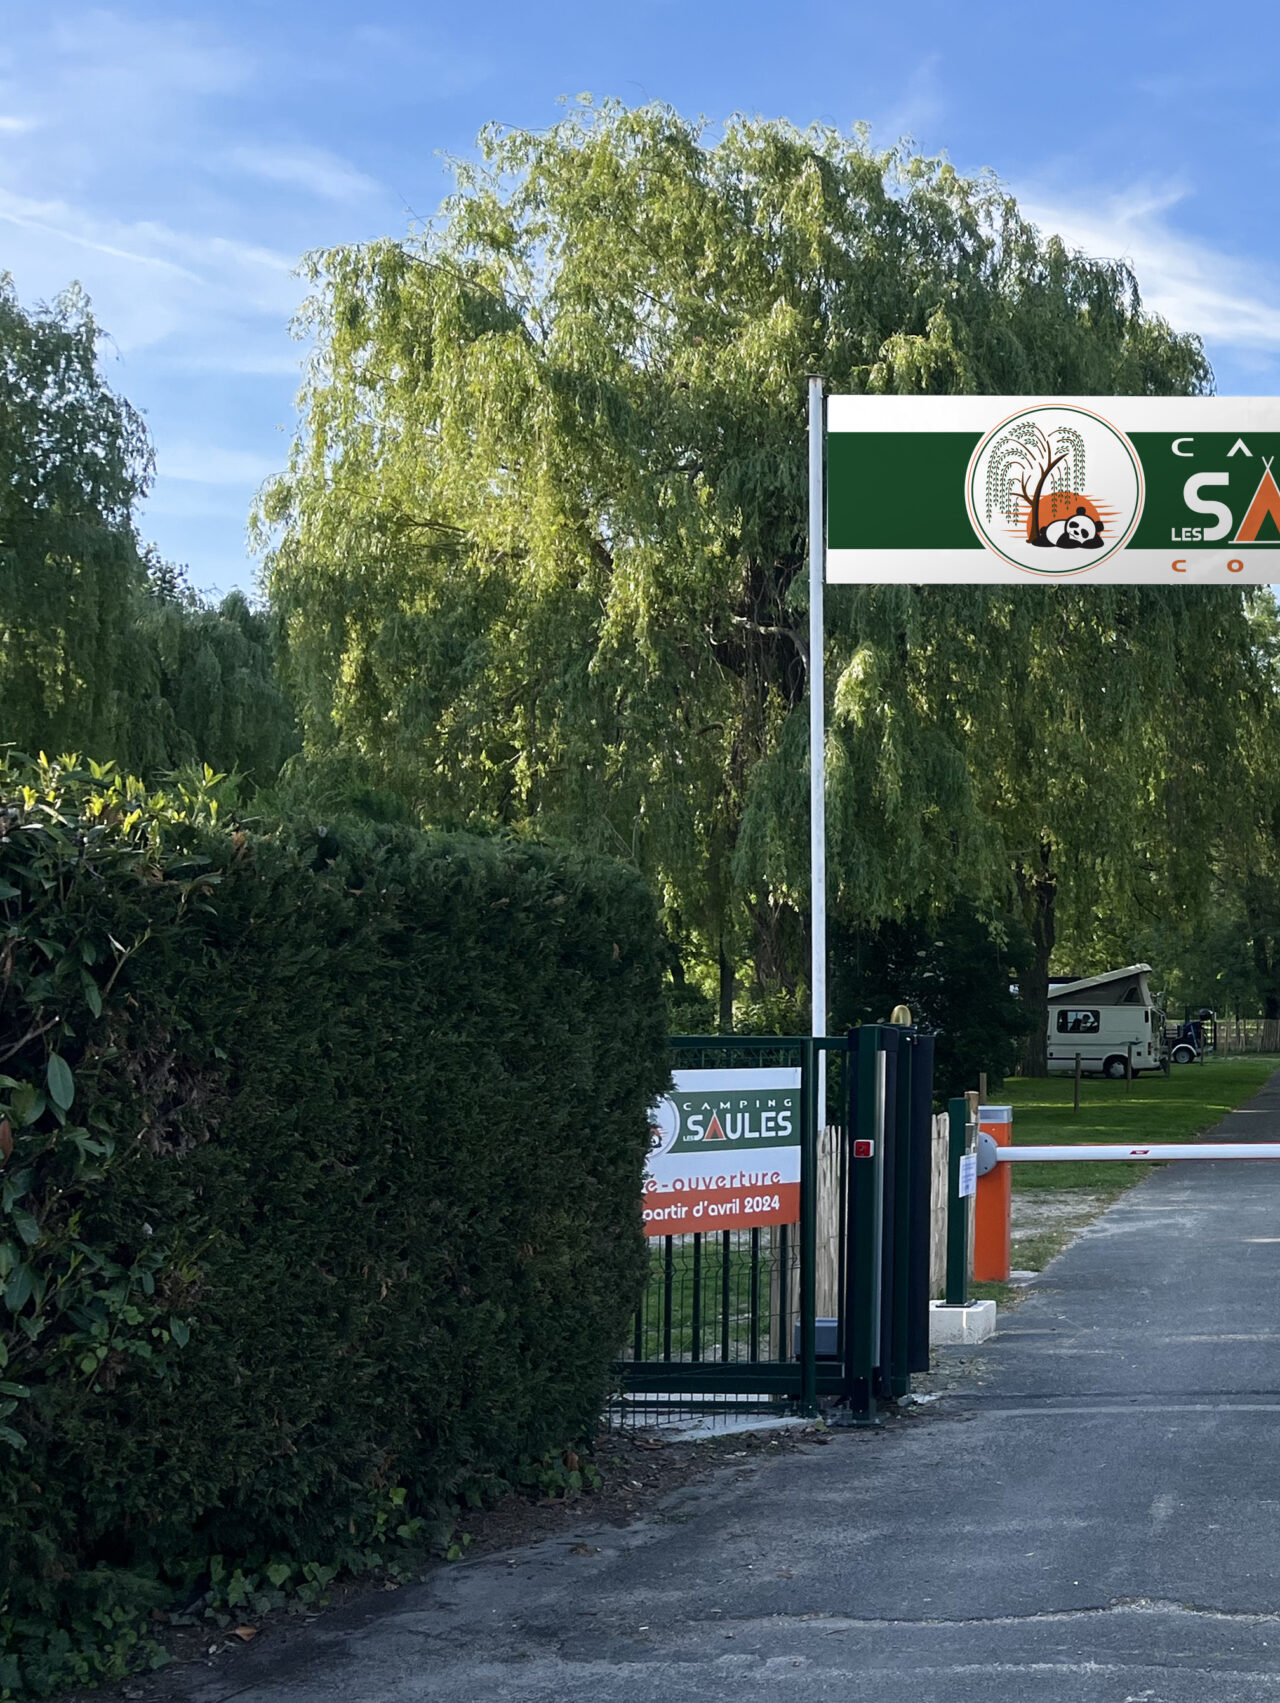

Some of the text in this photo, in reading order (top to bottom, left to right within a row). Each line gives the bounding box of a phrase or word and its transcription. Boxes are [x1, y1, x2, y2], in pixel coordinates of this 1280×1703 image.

[1171, 527, 1202, 541] LES
[683, 1099, 792, 1111] CAMPING
[687, 1108, 792, 1141] SAULES
[645, 1170, 781, 1194] e-ouverture
[693, 1197, 740, 1218] d'avril
[744, 1194, 780, 1213] 2024
